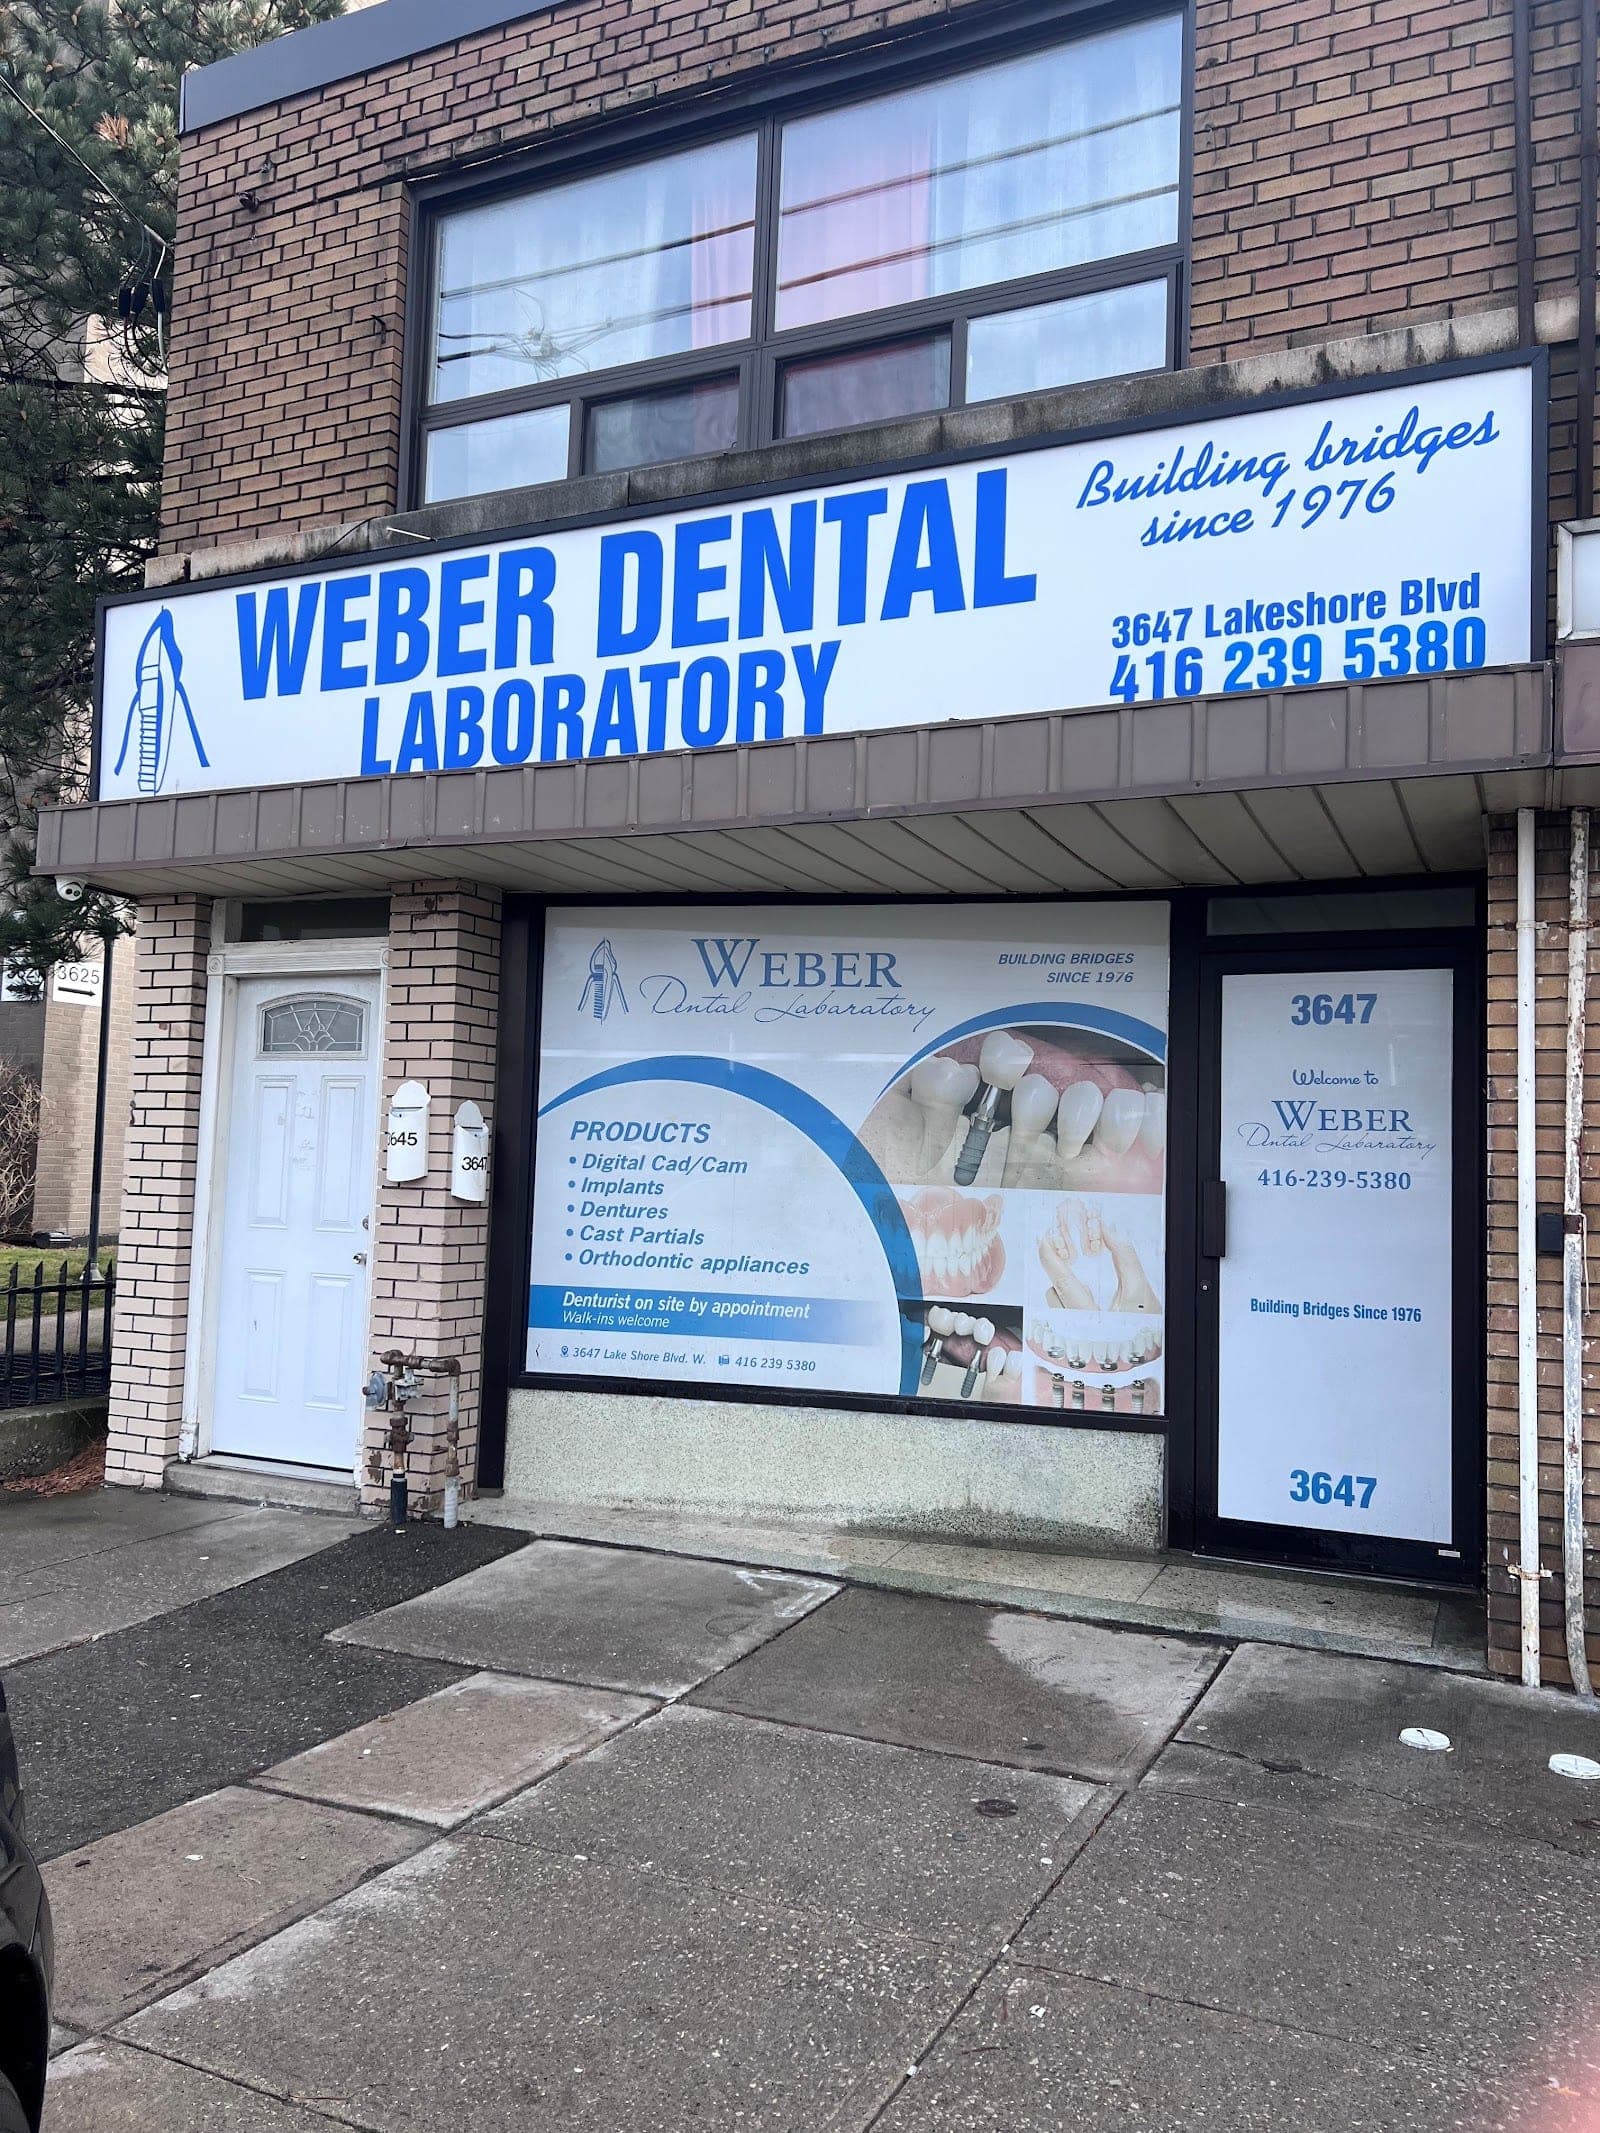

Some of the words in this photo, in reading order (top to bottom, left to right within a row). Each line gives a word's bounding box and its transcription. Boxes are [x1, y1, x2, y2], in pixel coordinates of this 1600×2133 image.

[1076, 440, 1291, 510] Building
[1304, 405, 1501, 475] bridges
[1140, 508, 1255, 548] since
[1270, 470, 1396, 530] 1976
[235, 546, 557, 700] WEBER
[596, 468, 1037, 658] DENTAL
[1111, 607, 1194, 649] 3647
[1204, 590, 1387, 638] Lakeshore
[1399, 572, 1481, 616] Blvd
[1109, 646, 1204, 704] 416
[1222, 633, 1322, 693] 239
[1343, 617, 1487, 681] 5380
[360, 640, 842, 777] LABORATORY
[691, 938, 903, 988] WEBER
[998, 953, 1066, 965] BUILDING
[1070, 953, 1135, 965] BRIDGES
[57, 965, 100, 984] 3625
[1046, 972, 1092, 983] SINCE
[1095, 972, 1134, 983] 1976
[639, 974, 752, 1015] Dental
[1290, 993, 1378, 1026] 3647
[1292, 1069, 1361, 1086] Welcome
[1363, 1070, 1379, 1085] to
[1271, 1100, 1414, 1132] WEBER
[570, 1120, 711, 1144] PRODUCTS
[1237, 1122, 1314, 1148] Dental
[582, 1153, 646, 1173] Digital
[651, 1155, 748, 1175] Cad/Cam
[581, 1177, 665, 1197] Implants
[1257, 1168, 1412, 1190] 416-239-5380
[580, 1201, 669, 1219] Dentures
[580, 1225, 625, 1242] Cast
[629, 1227, 705, 1245] Partials
[579, 1249, 694, 1269] Orthodontic
[700, 1255, 810, 1275] appliances
[562, 1291, 631, 1310] Denturist
[634, 1296, 654, 1311] on
[657, 1296, 685, 1313] site
[689, 1297, 708, 1316] by
[711, 1300, 811, 1319] appointment
[1250, 1298, 1300, 1318] Building
[1303, 1301, 1350, 1320] Bridges
[1353, 1304, 1388, 1320] Since
[1391, 1307, 1422, 1323] 1976
[562, 1311, 615, 1326] Walk-ins
[618, 1315, 670, 1328] welcome
[572, 1347, 600, 1359] 3647
[603, 1348, 627, 1360] Lake
[630, 1350, 660, 1362] Shore
[662, 1353, 688, 1364] Blvd.
[692, 1354, 706, 1365] W.
[734, 1356, 757, 1368] 416
[760, 1358, 783, 1370] 239
[786, 1360, 816, 1372] 5380
[1289, 1469, 1377, 1509] 3647
